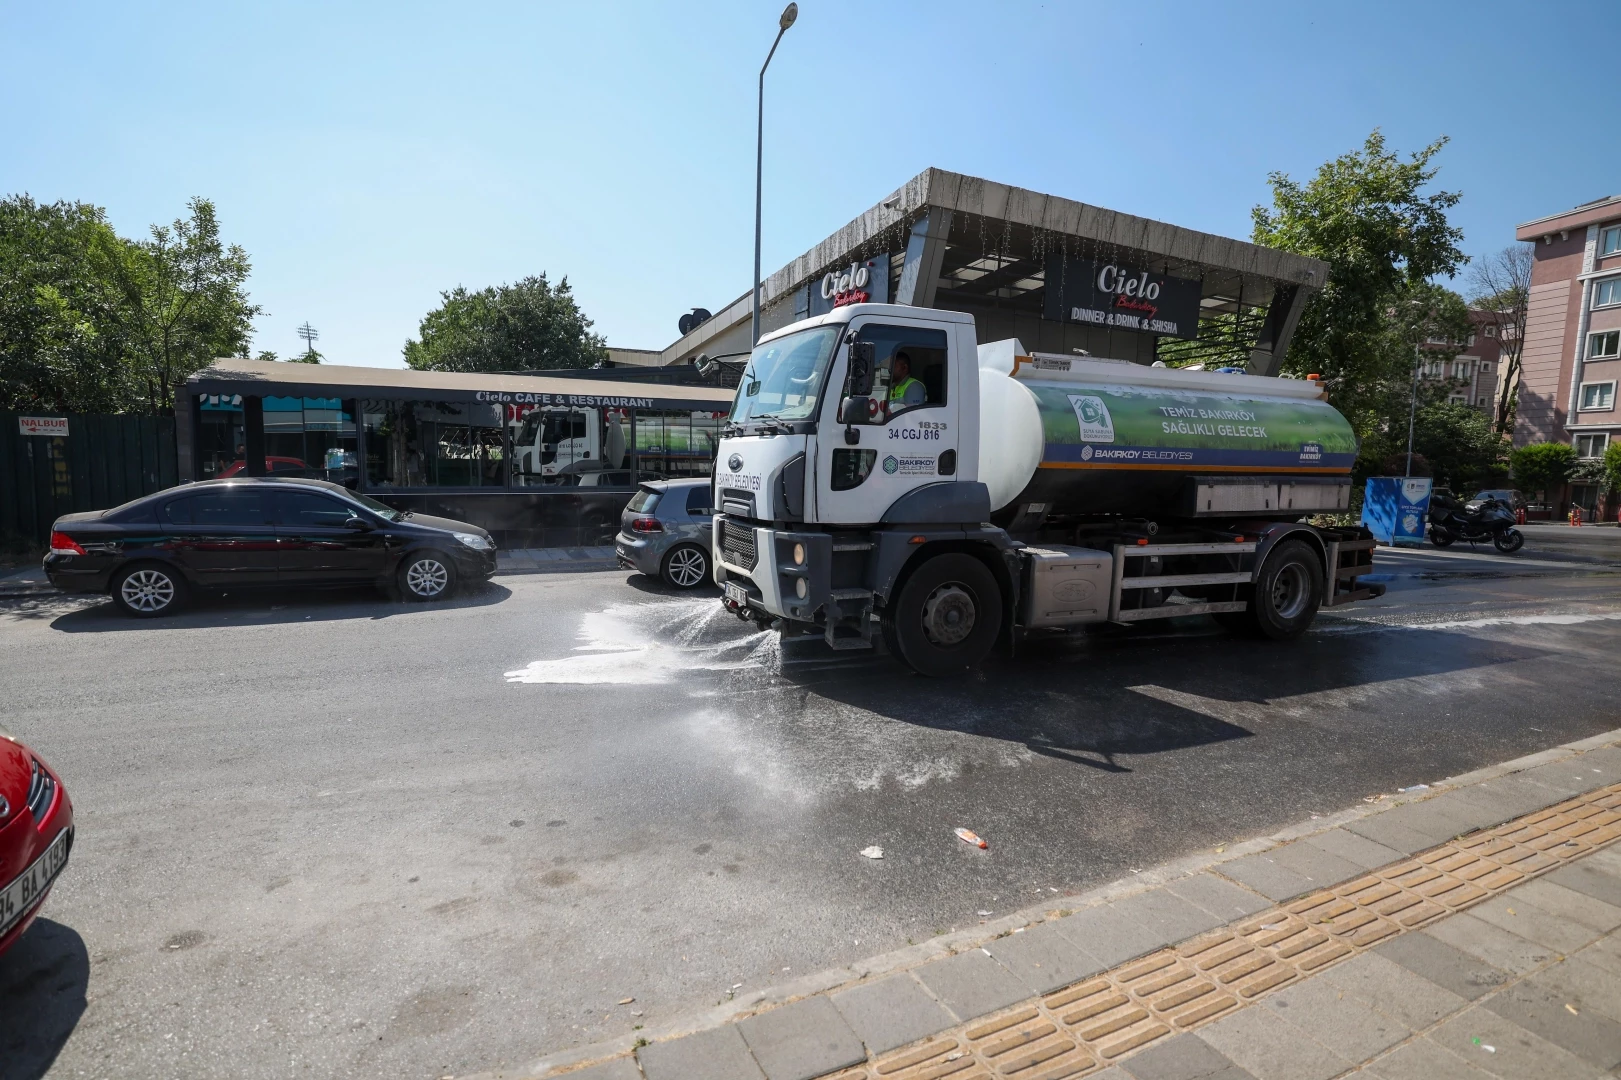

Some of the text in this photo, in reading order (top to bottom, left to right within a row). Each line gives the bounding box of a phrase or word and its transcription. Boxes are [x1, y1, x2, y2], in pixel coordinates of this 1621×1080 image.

[821, 261, 869, 299] Cielo
[1097, 265, 1160, 300] Cielo
[1071, 307, 1178, 334] DINNER & DRINK & SHISHA
[475, 391, 654, 408] Cielo CAFE & RESTAURANT
[1159, 405, 1256, 421] TEMİZ BAKIRKÖY
[21, 419, 66, 428] NALBUR
[918, 421, 947, 430] 1833
[1162, 420, 1268, 437] SAĞLIKLI GELECEK
[888, 428, 940, 440] 34 CGJ 816
[1094, 449, 1140, 459] BAKIRKÖY
[21, 869, 38, 904] BA
[41, 839, 66, 880] 4193
